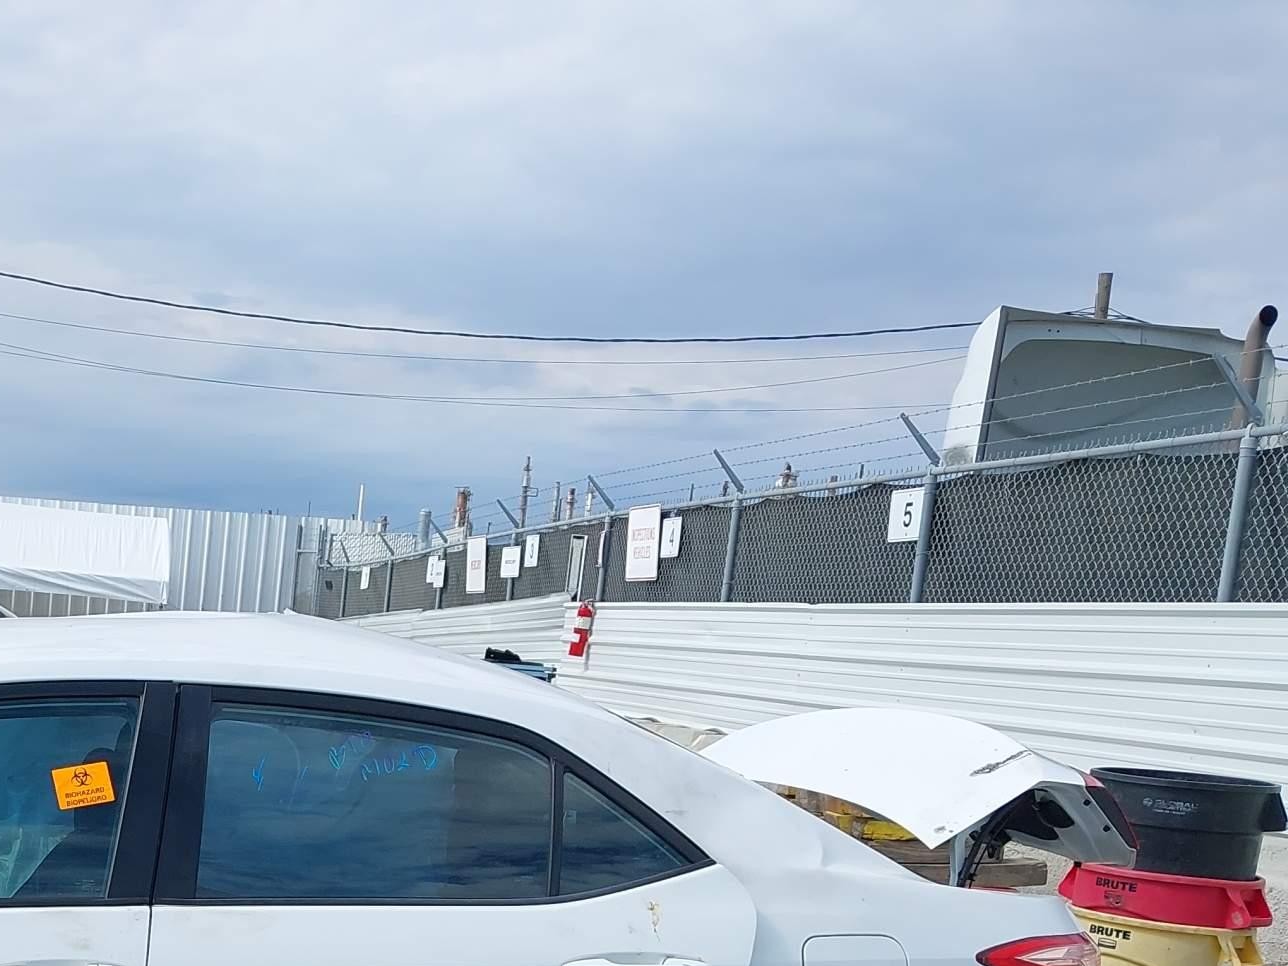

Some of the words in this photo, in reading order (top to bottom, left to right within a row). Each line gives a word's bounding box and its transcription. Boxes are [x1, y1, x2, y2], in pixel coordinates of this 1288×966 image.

[902, 501, 914, 528] 5
[668, 526, 676, 548] 4
[64, 786, 105, 800] BIOHAZARD
[1096, 876, 1137, 893] BRUTE
[1089, 923, 1132, 941] BRUTE
